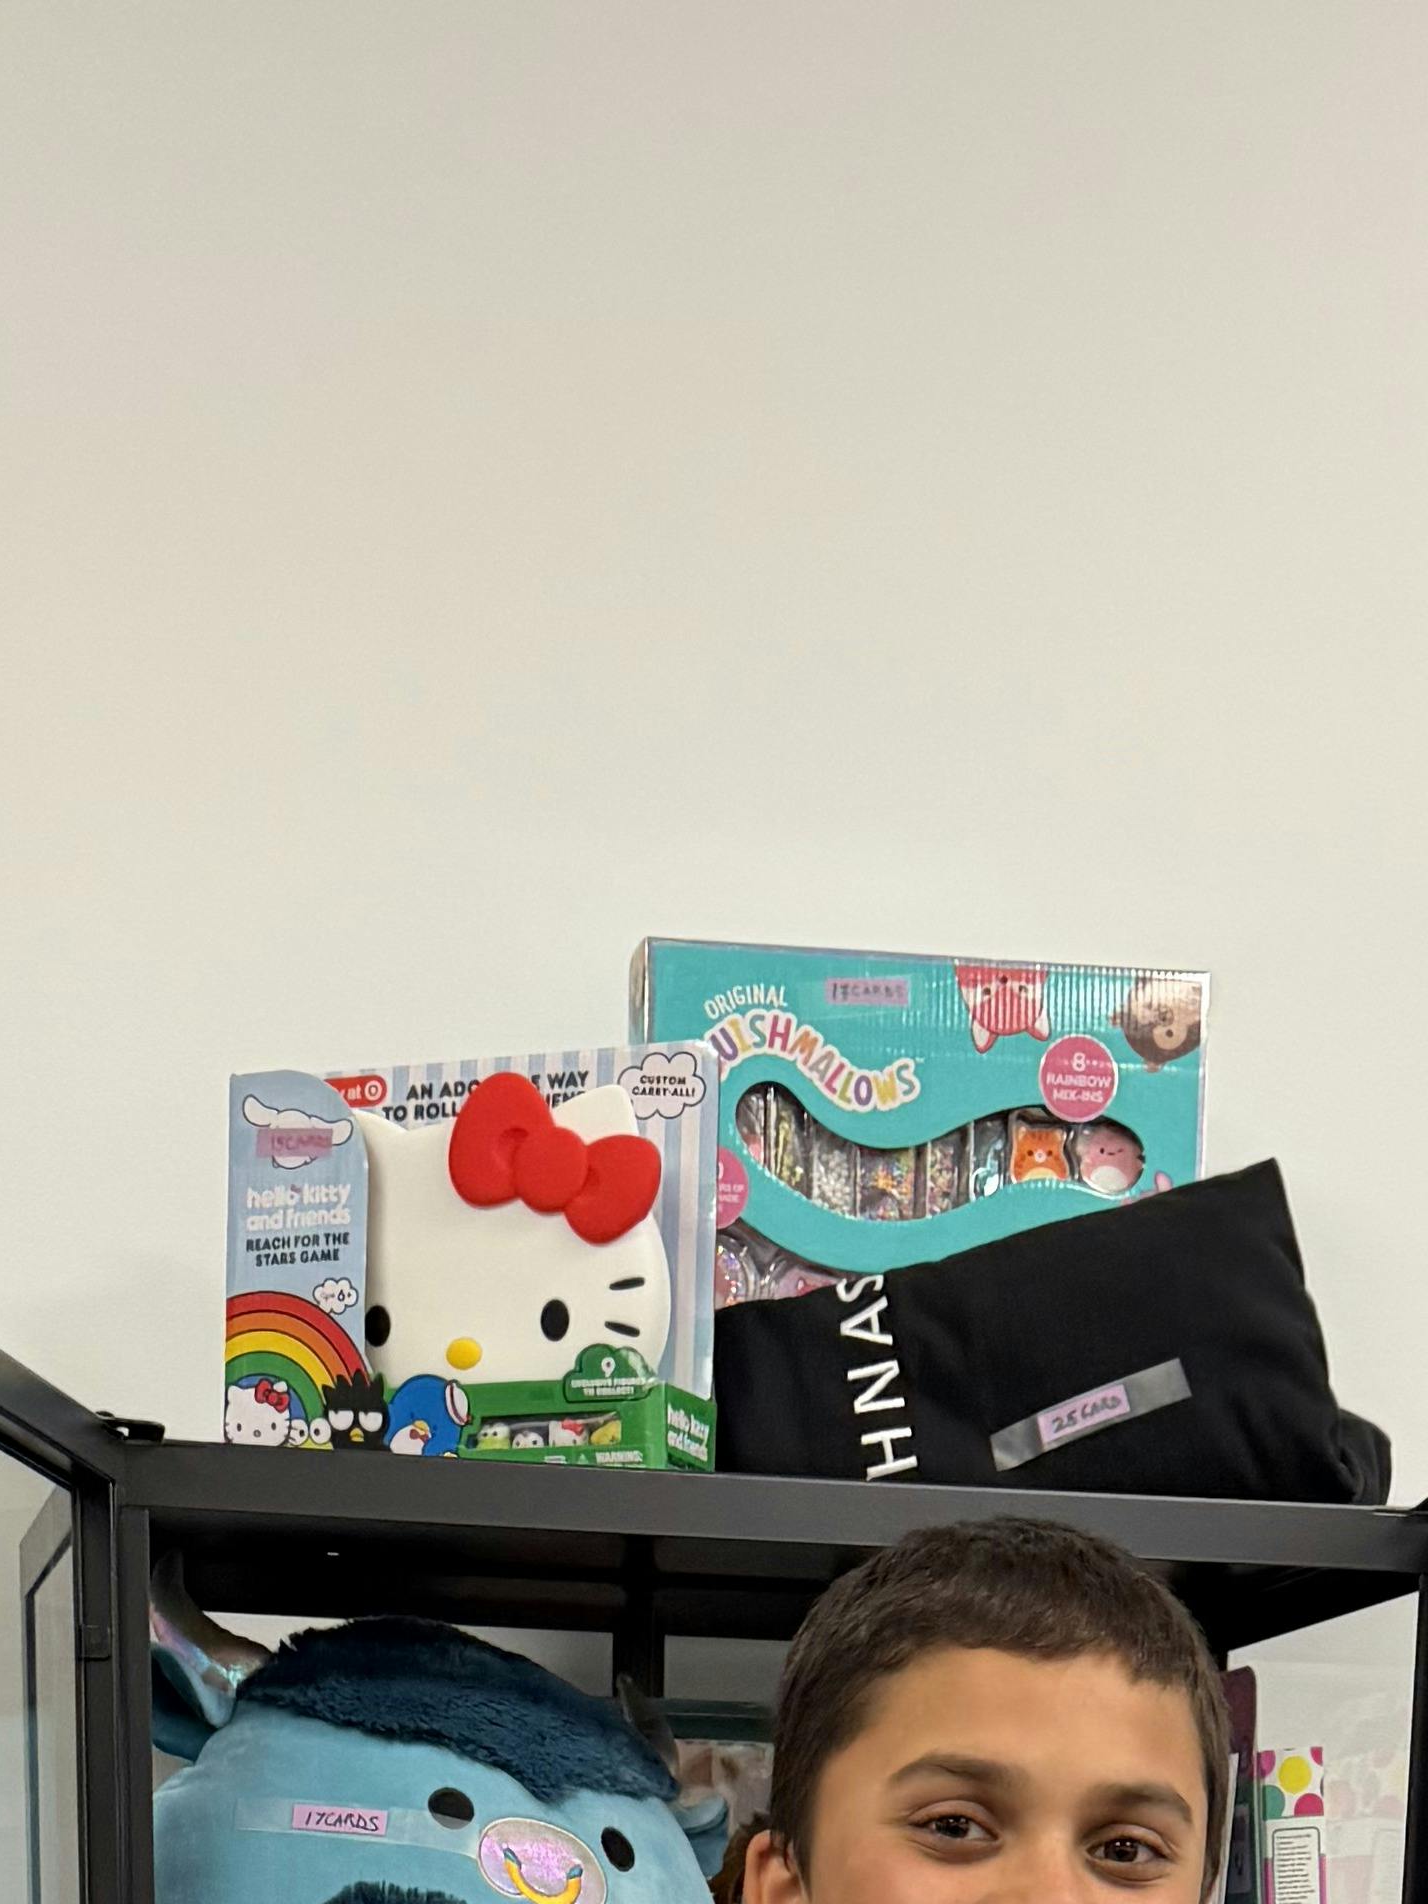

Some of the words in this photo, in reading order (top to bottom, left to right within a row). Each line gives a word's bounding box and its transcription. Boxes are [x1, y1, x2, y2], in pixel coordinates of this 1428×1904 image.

[703, 982, 789, 1020] ORIGINAL
[706, 1009, 921, 1112] UISHMALLOWS
[1072, 1052, 1087, 1073] 8
[406, 1083, 435, 1101] AN
[546, 1070, 590, 1089] WAY
[638, 1074, 687, 1087] CUSTOM
[1045, 1072, 1113, 1089] RAINBOW
[1052, 1088, 1104, 1104] MIX-INS
[382, 1105, 408, 1122] TO
[412, 1102, 458, 1121] ROLL
[246, 1183, 300, 1209] hello
[302, 1182, 351, 1208] kitty
[246, 1209, 283, 1232] and
[284, 1206, 351, 1230] friends
[245, 1235, 291, 1253] REACH
[293, 1233, 320, 1249] FOR
[324, 1231, 350, 1247] THE
[255, 1250, 296, 1268] STARS
[299, 1248, 340, 1264] GAME
